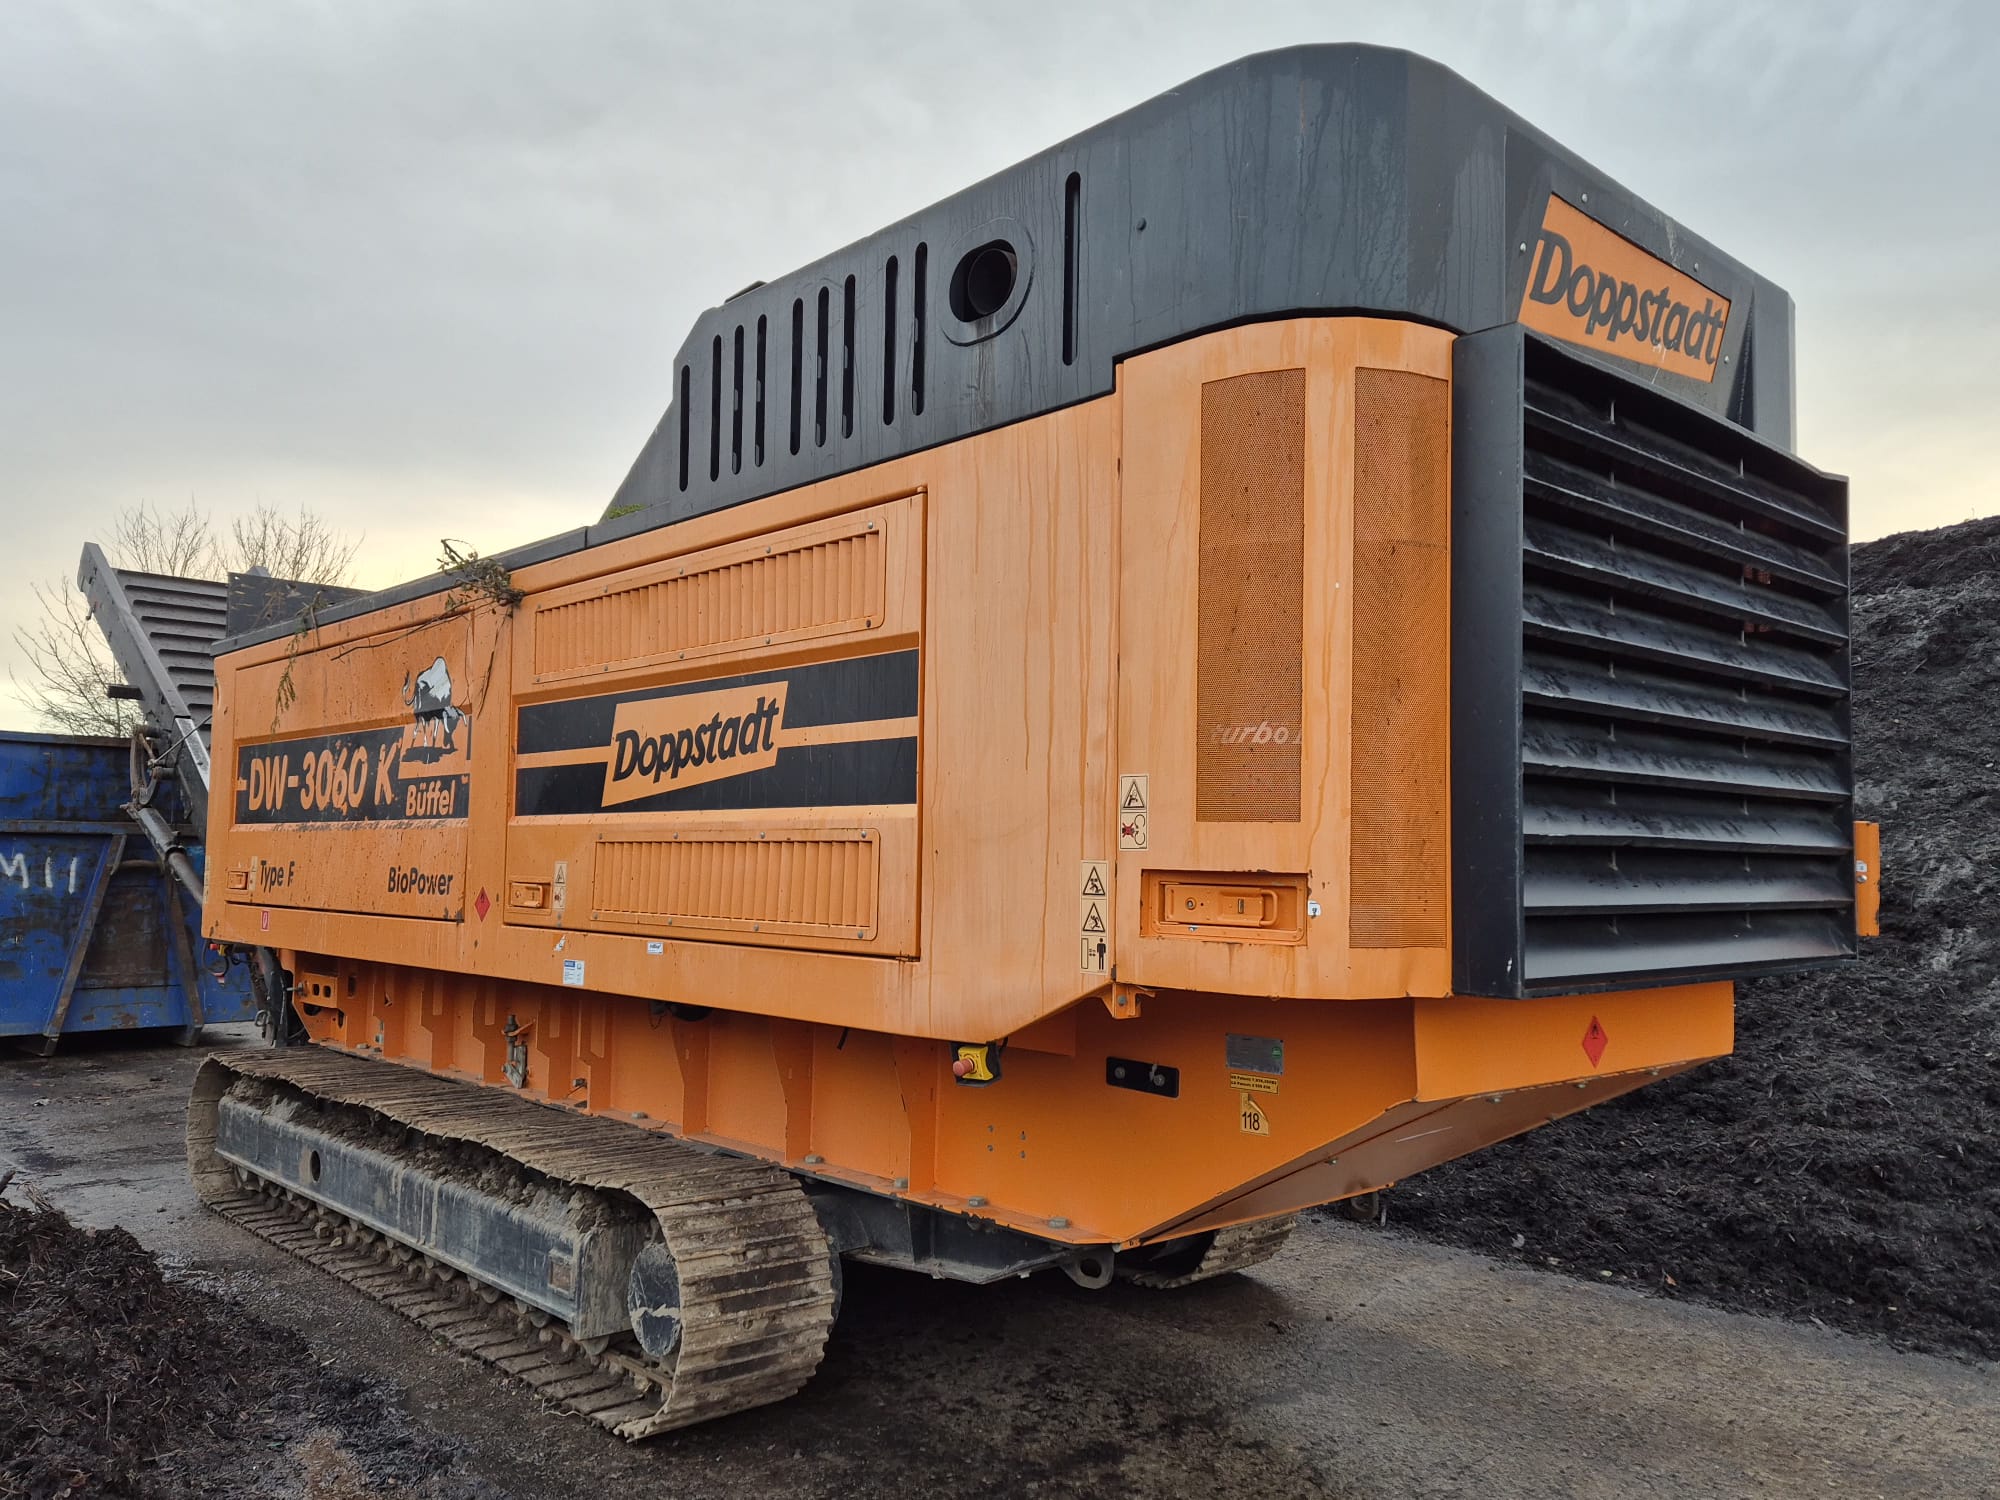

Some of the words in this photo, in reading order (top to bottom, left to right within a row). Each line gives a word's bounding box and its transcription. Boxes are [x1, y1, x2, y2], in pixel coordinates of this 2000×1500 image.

[1529, 229, 1723, 365] Doppstadt
[612, 696, 779, 784] Doppstadt
[249, 746, 368, 811] DW-3060
[374, 742, 399, 805] K
[405, 780, 456, 817] Büffel
[260, 860, 284, 893] Type
[287, 861, 295, 887] F
[388, 866, 453, 896] BioPower
[1242, 1111, 1260, 1130] 118
